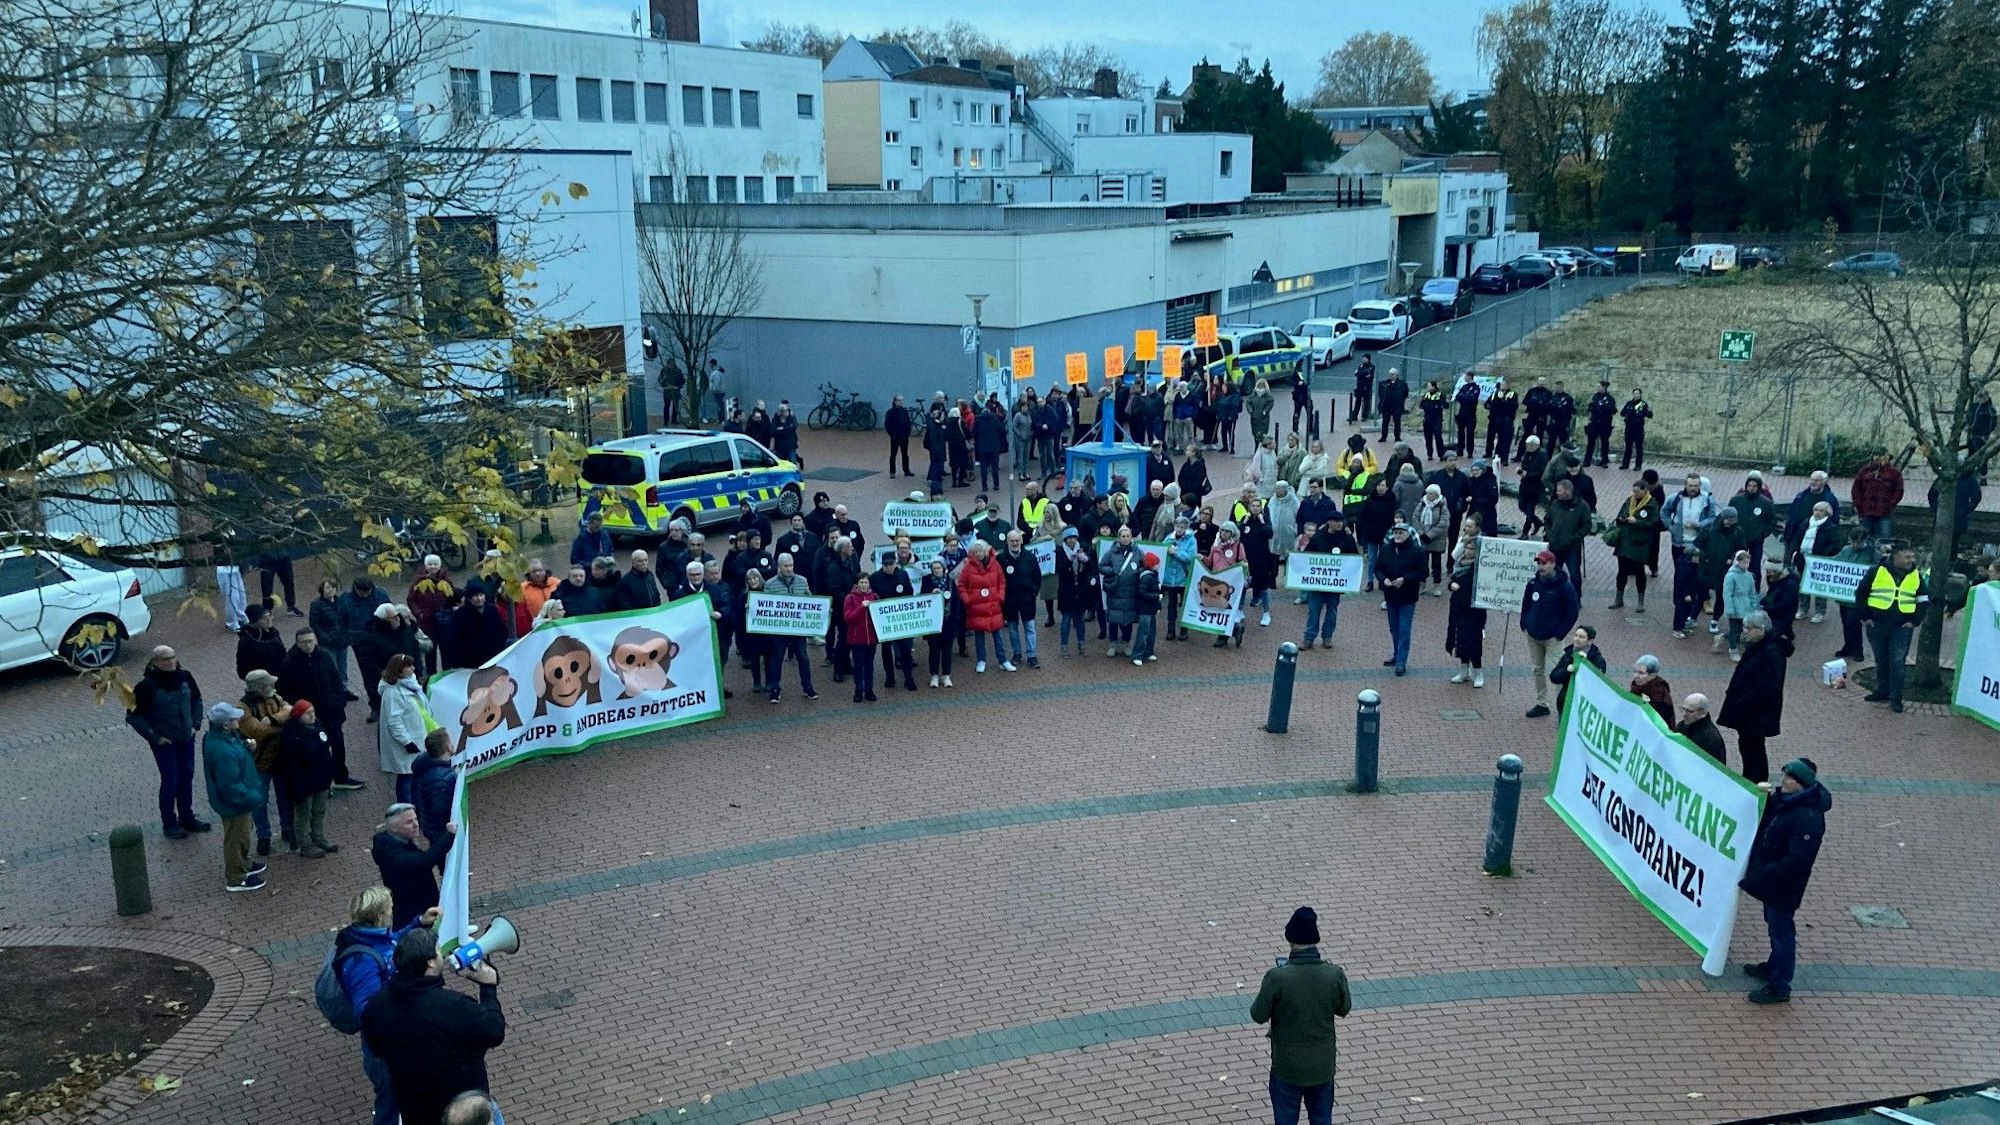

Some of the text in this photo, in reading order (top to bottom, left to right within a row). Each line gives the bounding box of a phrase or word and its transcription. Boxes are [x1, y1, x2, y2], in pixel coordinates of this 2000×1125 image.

[890, 507, 945, 517] KÖNIGSDORF
[888, 518, 947, 527] WILL DIALOG!
[1485, 542, 1523, 556] Schluss
[1309, 557, 1342, 567] DIALOG
[1310, 566, 1340, 577] STATT
[1810, 571, 1831, 582] MUSS
[1301, 576, 1348, 587] MONOLOG!
[1810, 581, 1827, 592] FREI
[757, 599, 822, 611] WIR SIND KEINE
[879, 600, 932, 615] SCHLUSS MIT
[805, 612, 821, 620] WIR
[886, 610, 926, 624] TAUBHEIT
[752, 617, 823, 629] FORDERN DIALOG!
[882, 619, 933, 634] IM RATHAUS!
[509, 724, 557, 751] STUPP
[562, 723, 572, 737] &
[576, 706, 636, 735] ANDREAS
[640, 690, 706, 717] PÖTTGEN
[1577, 696, 1738, 861] KEINE AKZEPTANZ
[1581, 765, 1706, 908] BEI IGNORANZ!
